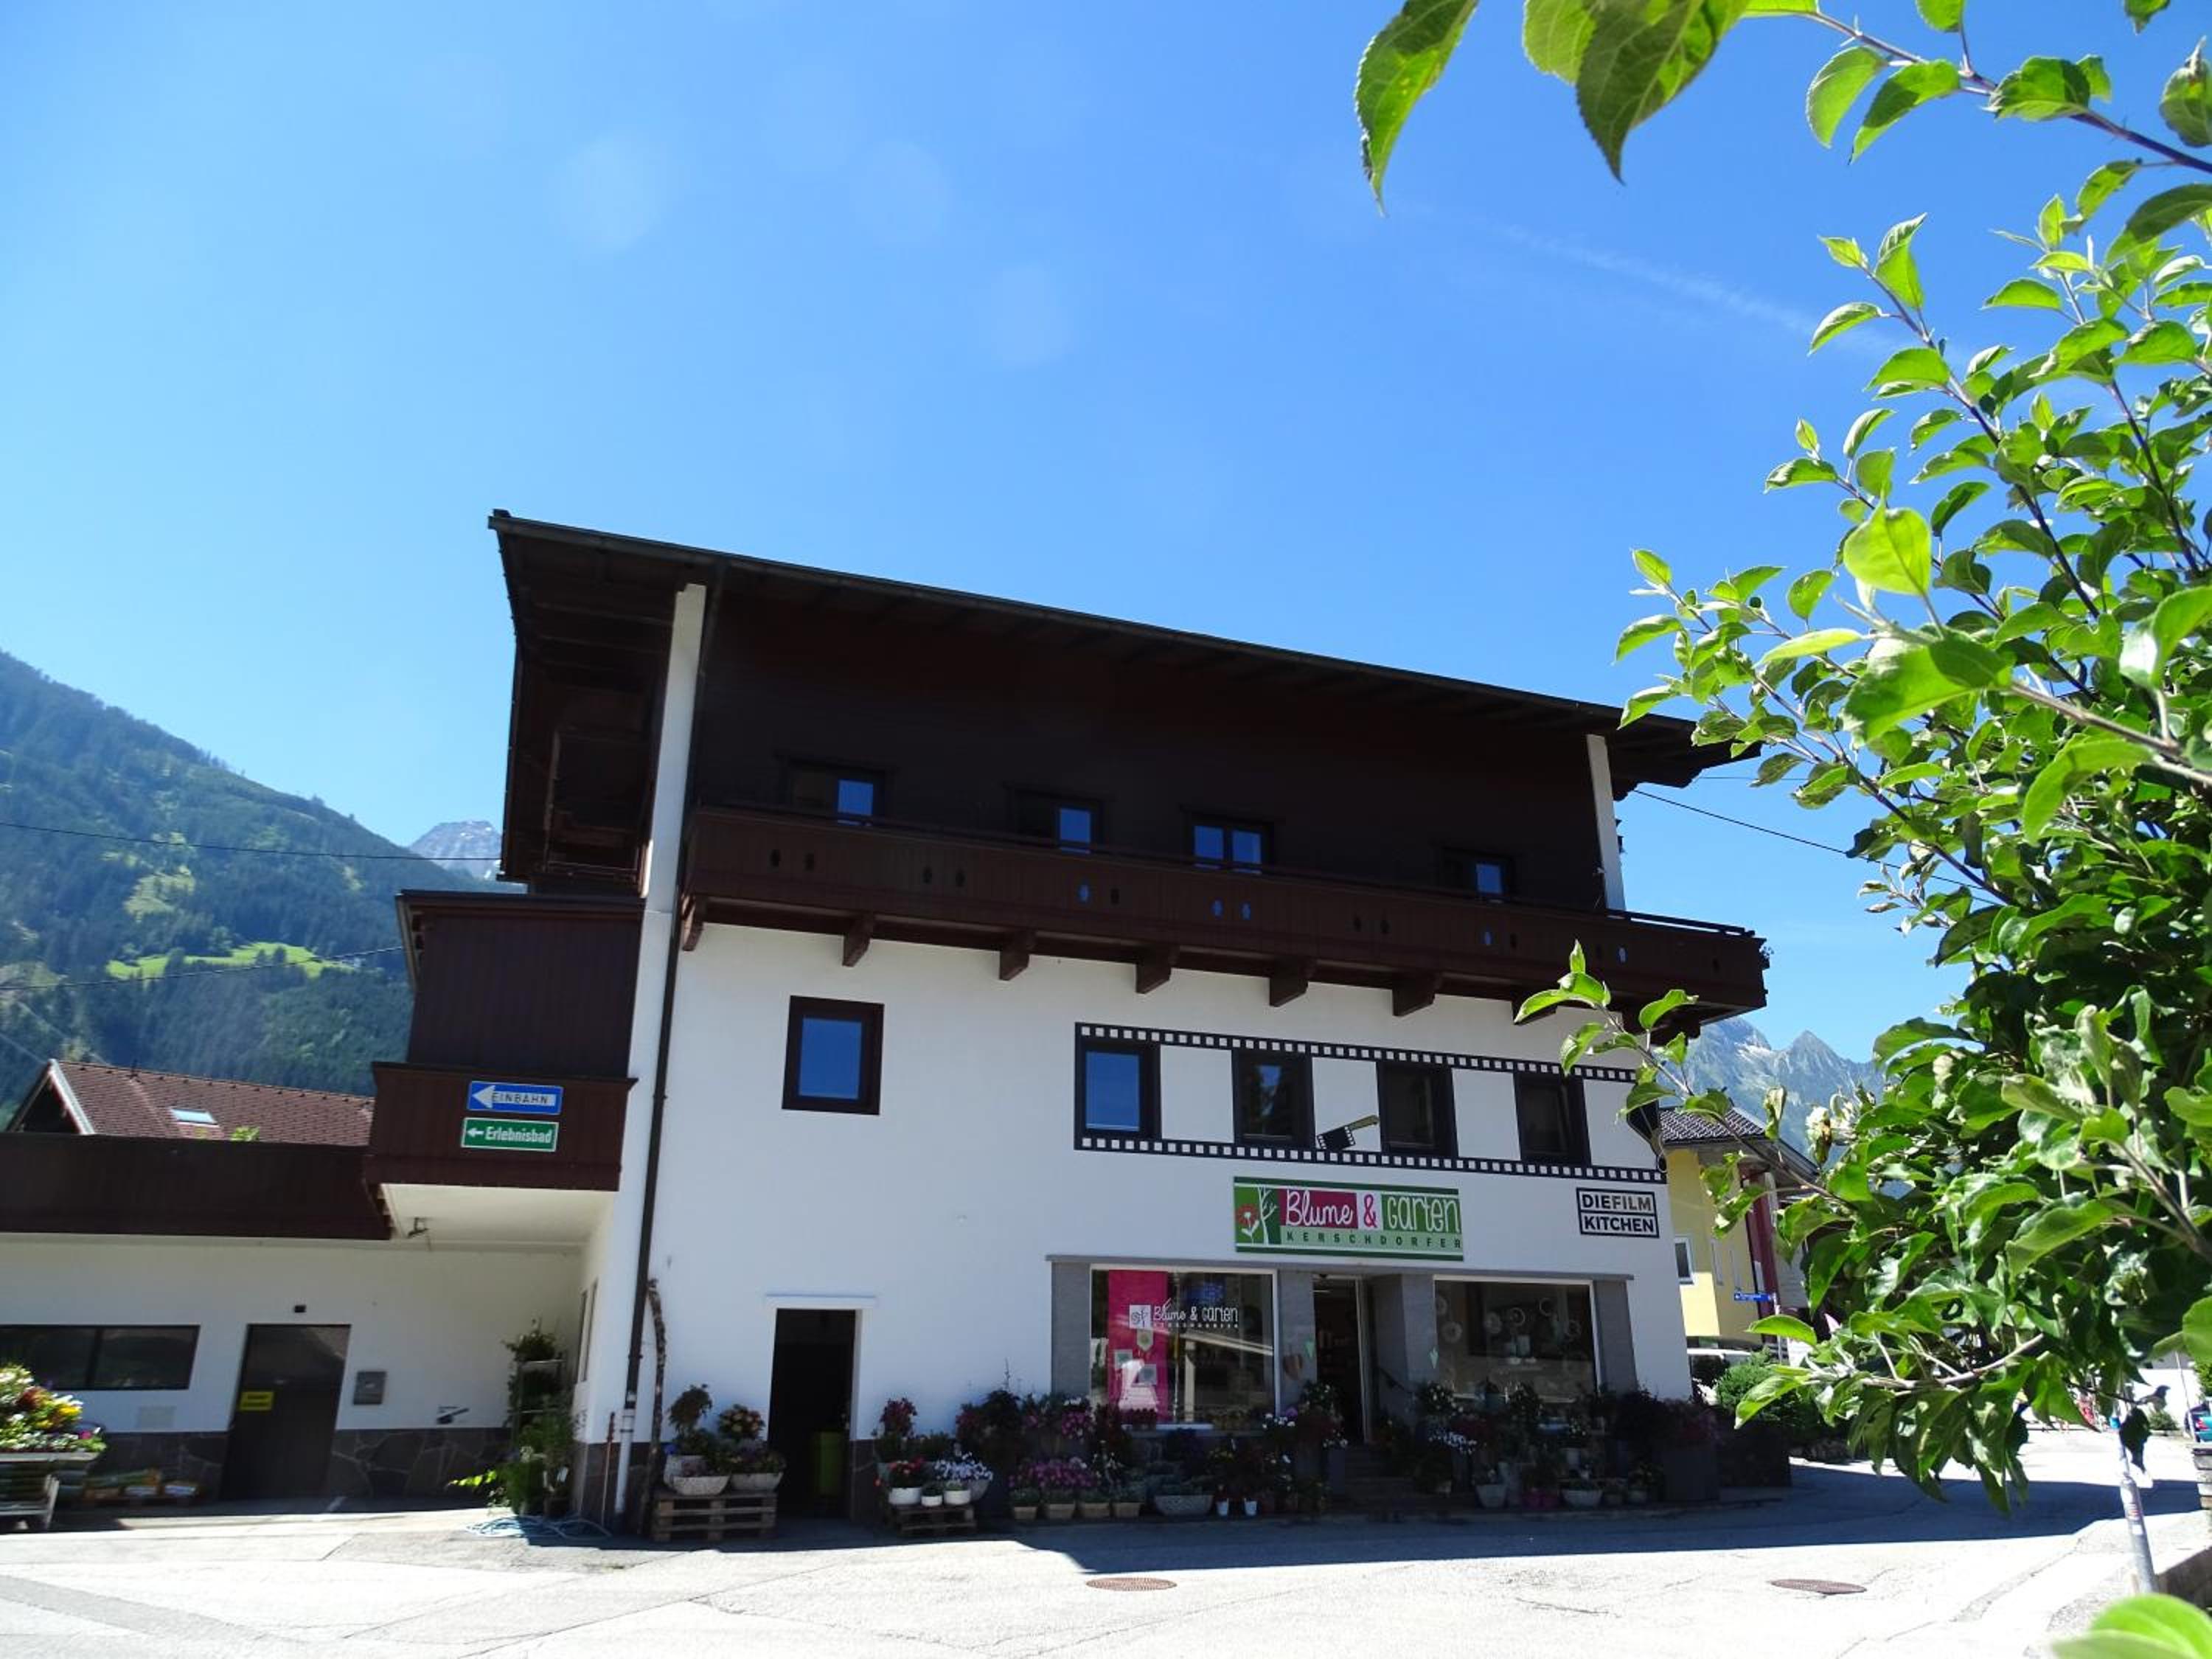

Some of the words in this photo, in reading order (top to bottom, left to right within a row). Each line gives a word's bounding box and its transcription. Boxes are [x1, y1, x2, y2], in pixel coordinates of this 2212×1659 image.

[492, 1092, 548, 1105] EINBAHN
[484, 1126, 552, 1143] Erlebnisbad
[1286, 1188, 1353, 1226] Blume
[1363, 1194, 1377, 1228] &
[1584, 1215, 1654, 1232] KITCHEN
[1287, 1231, 1461, 1248] KERSCHDORFER
